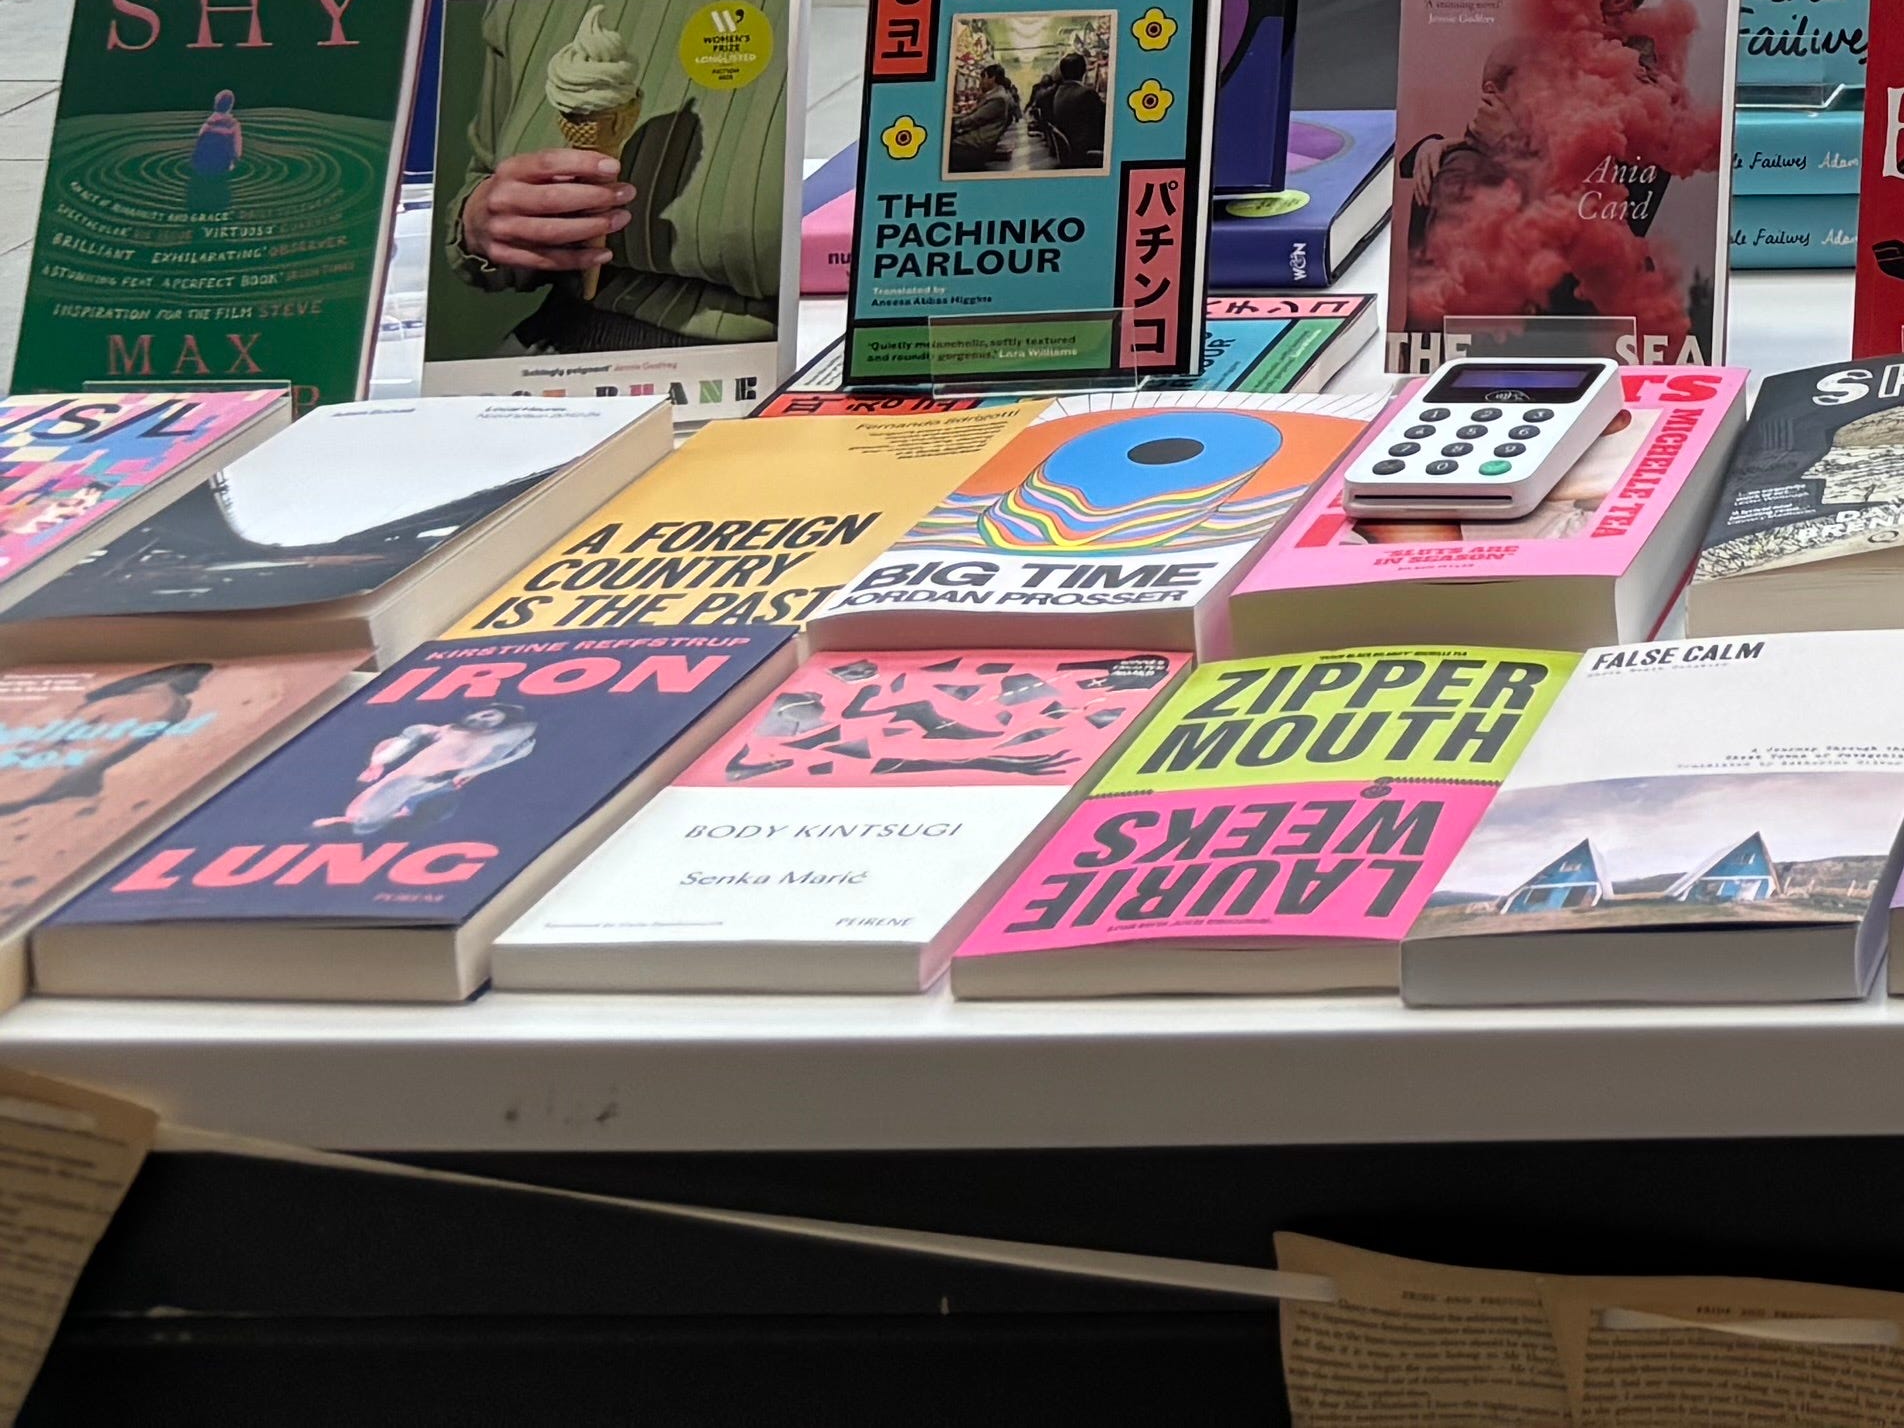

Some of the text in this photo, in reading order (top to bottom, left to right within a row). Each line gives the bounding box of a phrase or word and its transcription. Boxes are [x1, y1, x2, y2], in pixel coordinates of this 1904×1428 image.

[1582, 156, 1657, 185] Ania
[877, 192, 957, 219] THE
[1577, 191, 1652, 220] Card
[876, 217, 1085, 249] PACHINKO
[874, 248, 1060, 278] PARLOUR
[1131, 181, 1176, 354] パチンコ
[107, 334, 263, 375] MAX
[1592, 408, 1702, 537] MICHELLE TEA
[563, 512, 881, 555] A FOREIGN
[524, 551, 815, 590] COUNTRY
[859, 561, 1217, 592] BIG TIME
[474, 586, 847, 629] IS THE PAST
[833, 588, 1190, 611] JORDAN PROSSER
[425, 635, 751, 662] KIRSTINE REFFSTRUP
[1591, 642, 1765, 671] FALSE CALM
[368, 656, 730, 705] IRON
[1183, 662, 1550, 720] ZIPPER
[1137, 713, 1519, 775] MOUTH
[684, 823, 962, 840] BODY KINTSUGI
[1077, 798, 1441, 866] WEEKS
[112, 842, 499, 894] LUNG
[679, 869, 869, 886] Senka Marić
[1007, 856, 1431, 933] LAURIE
